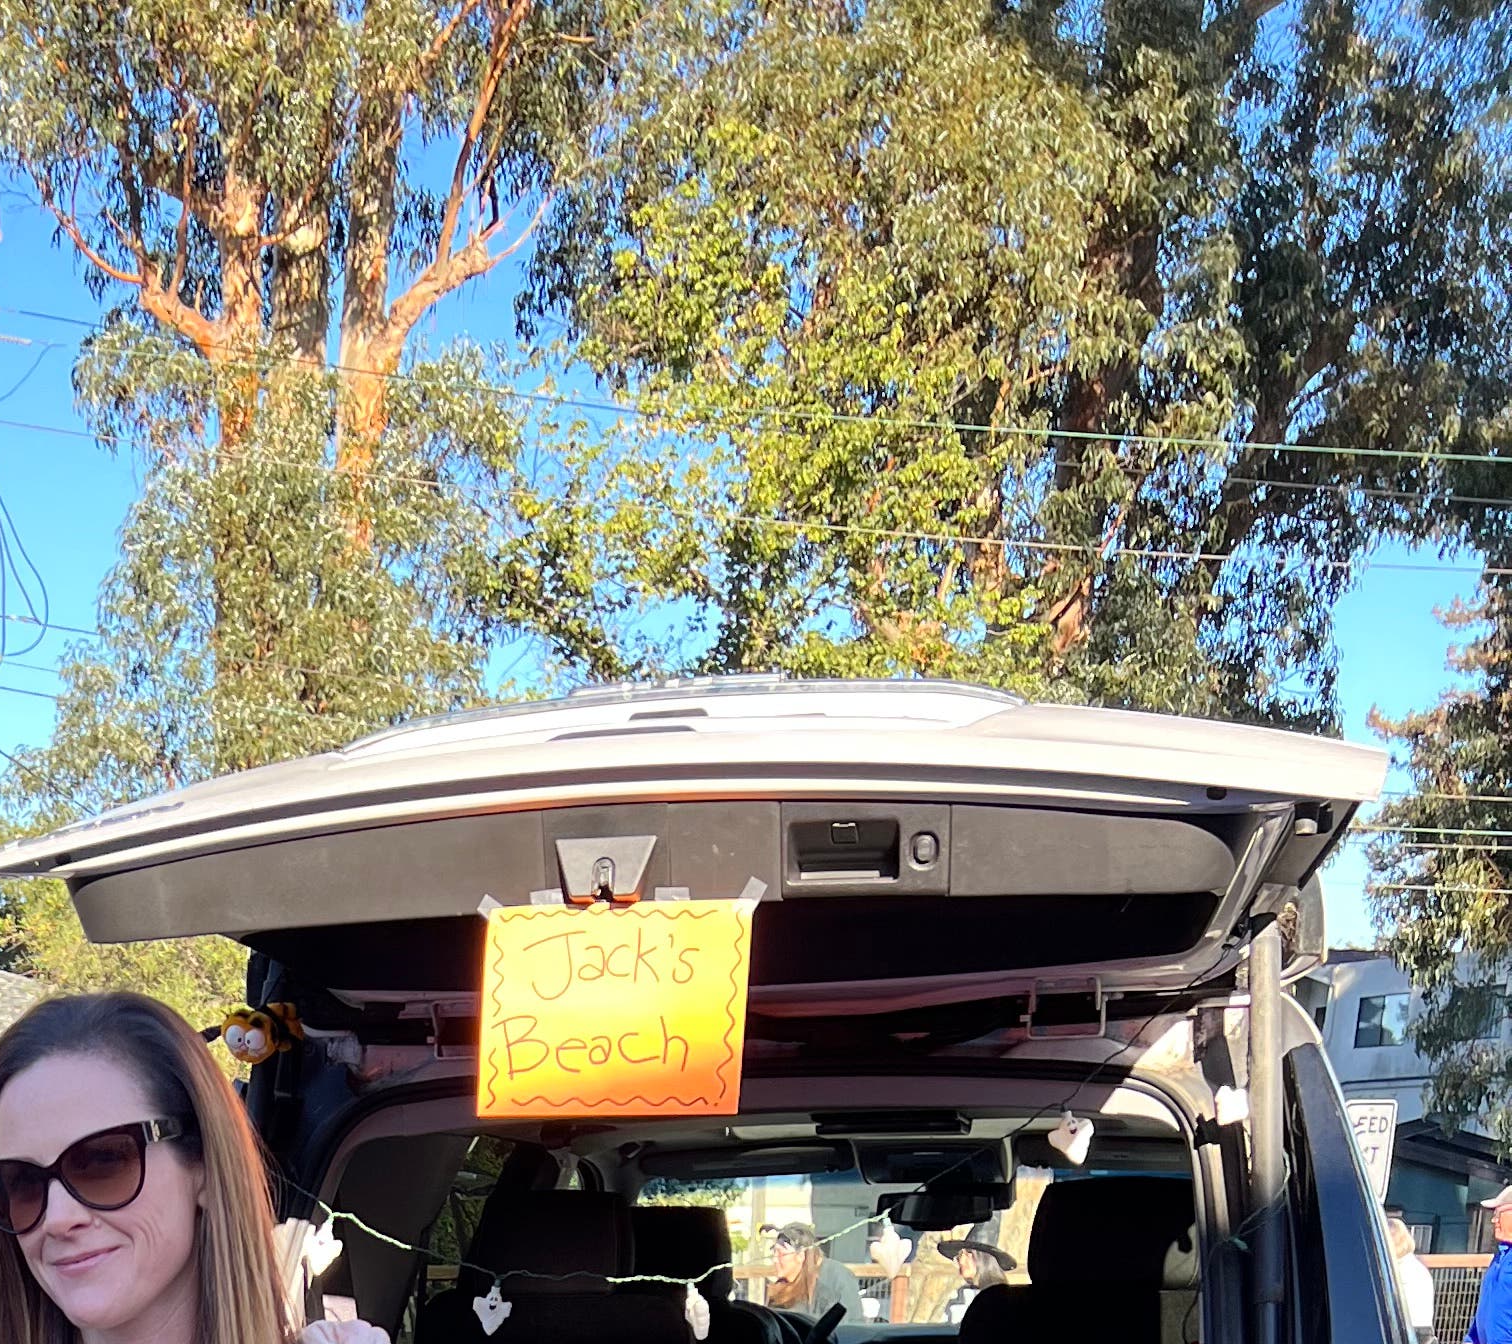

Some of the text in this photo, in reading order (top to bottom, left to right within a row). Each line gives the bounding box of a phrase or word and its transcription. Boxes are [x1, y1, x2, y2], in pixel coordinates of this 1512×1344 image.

[522, 927, 700, 1001] Jack's
[491, 1014, 689, 1081] Beach
[1352, 1115, 1389, 1135] EED
